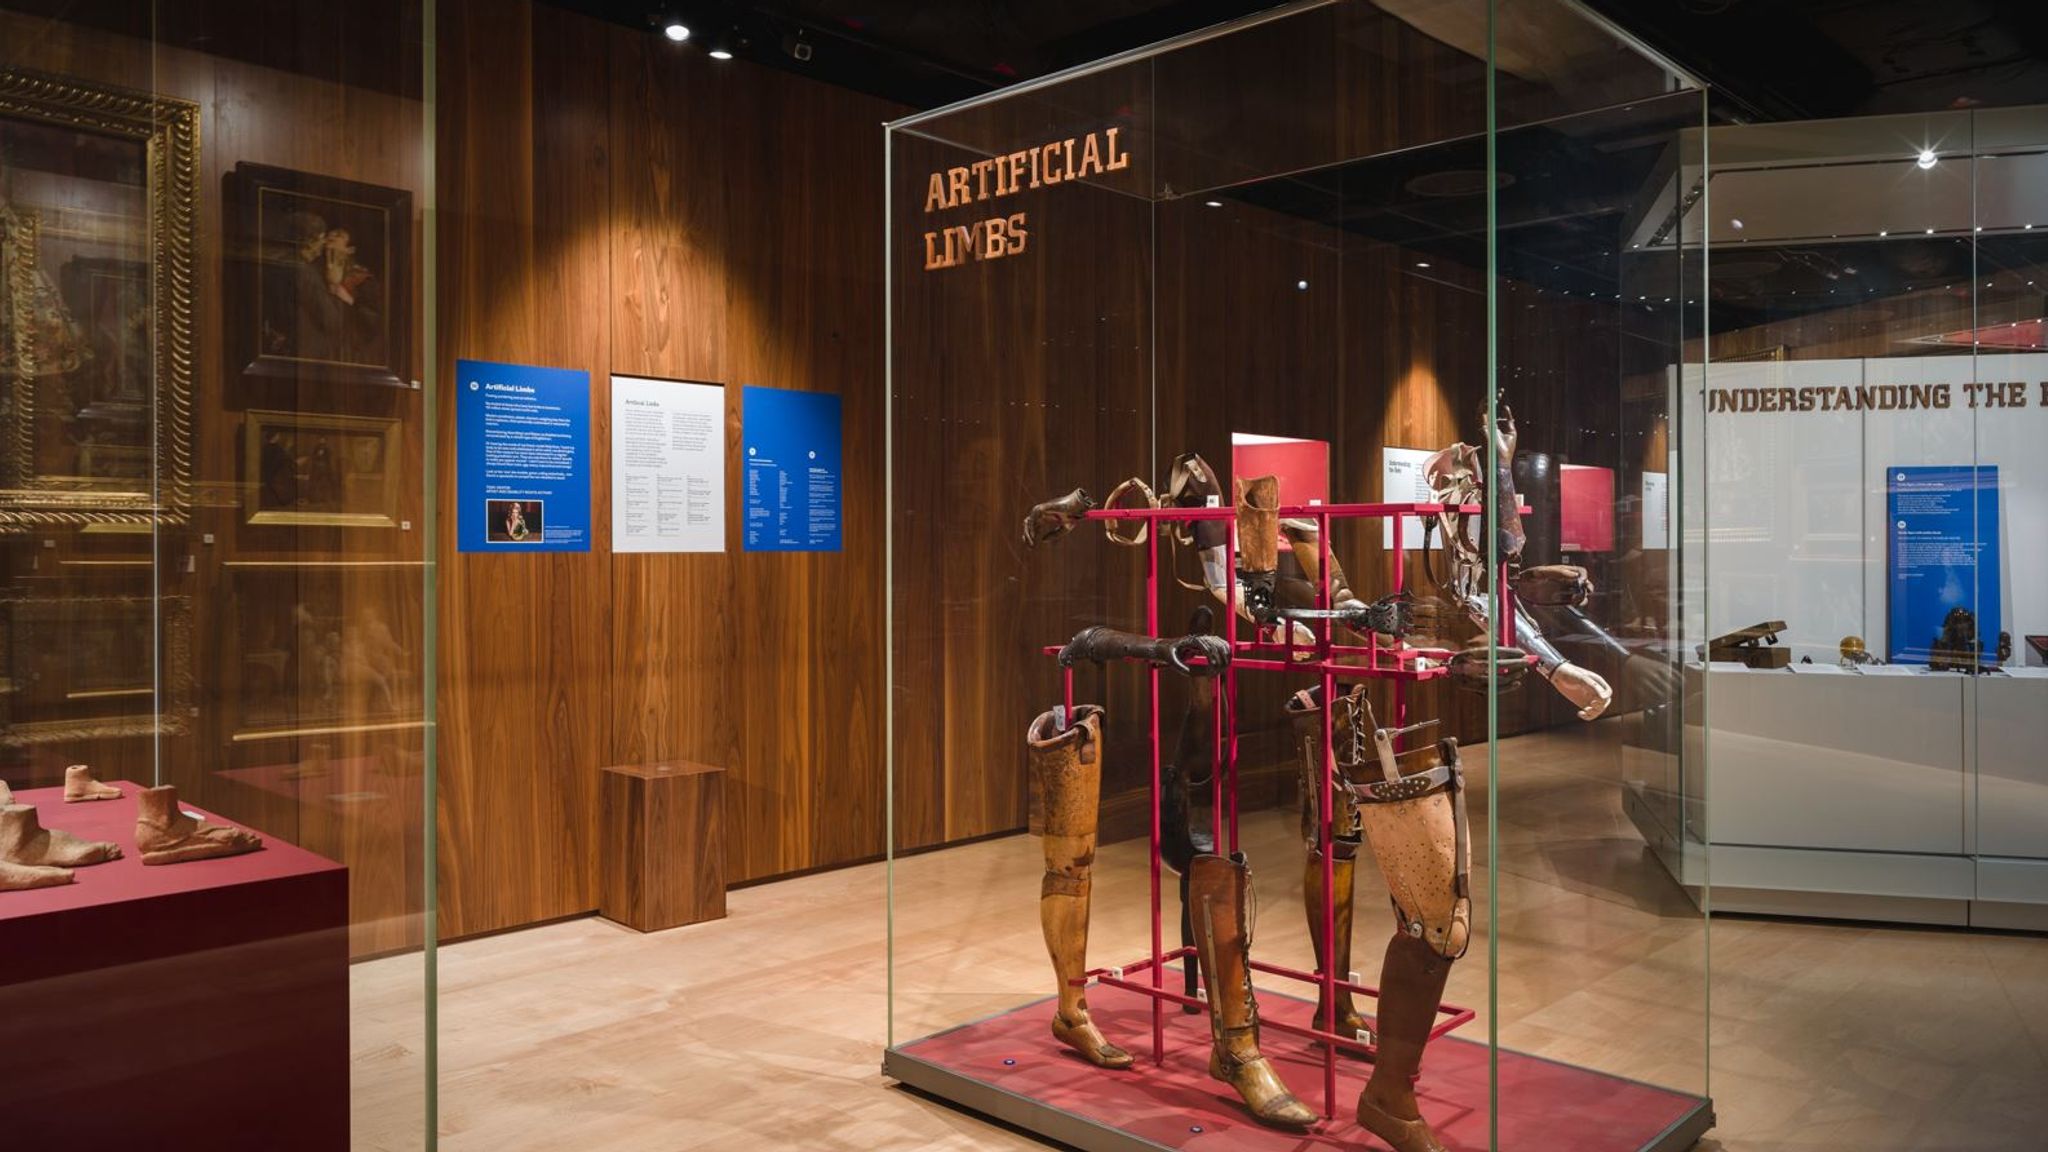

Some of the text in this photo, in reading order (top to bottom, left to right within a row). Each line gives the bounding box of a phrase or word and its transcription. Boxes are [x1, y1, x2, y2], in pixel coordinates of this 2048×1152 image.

[924, 127, 1131, 213] ARTIFICIAL
[924, 212, 1028, 271] LIMBS
[485, 383, 514, 392] Artificial
[515, 385, 535, 394] Limbs
[1963, 382, 2027, 408] THE
